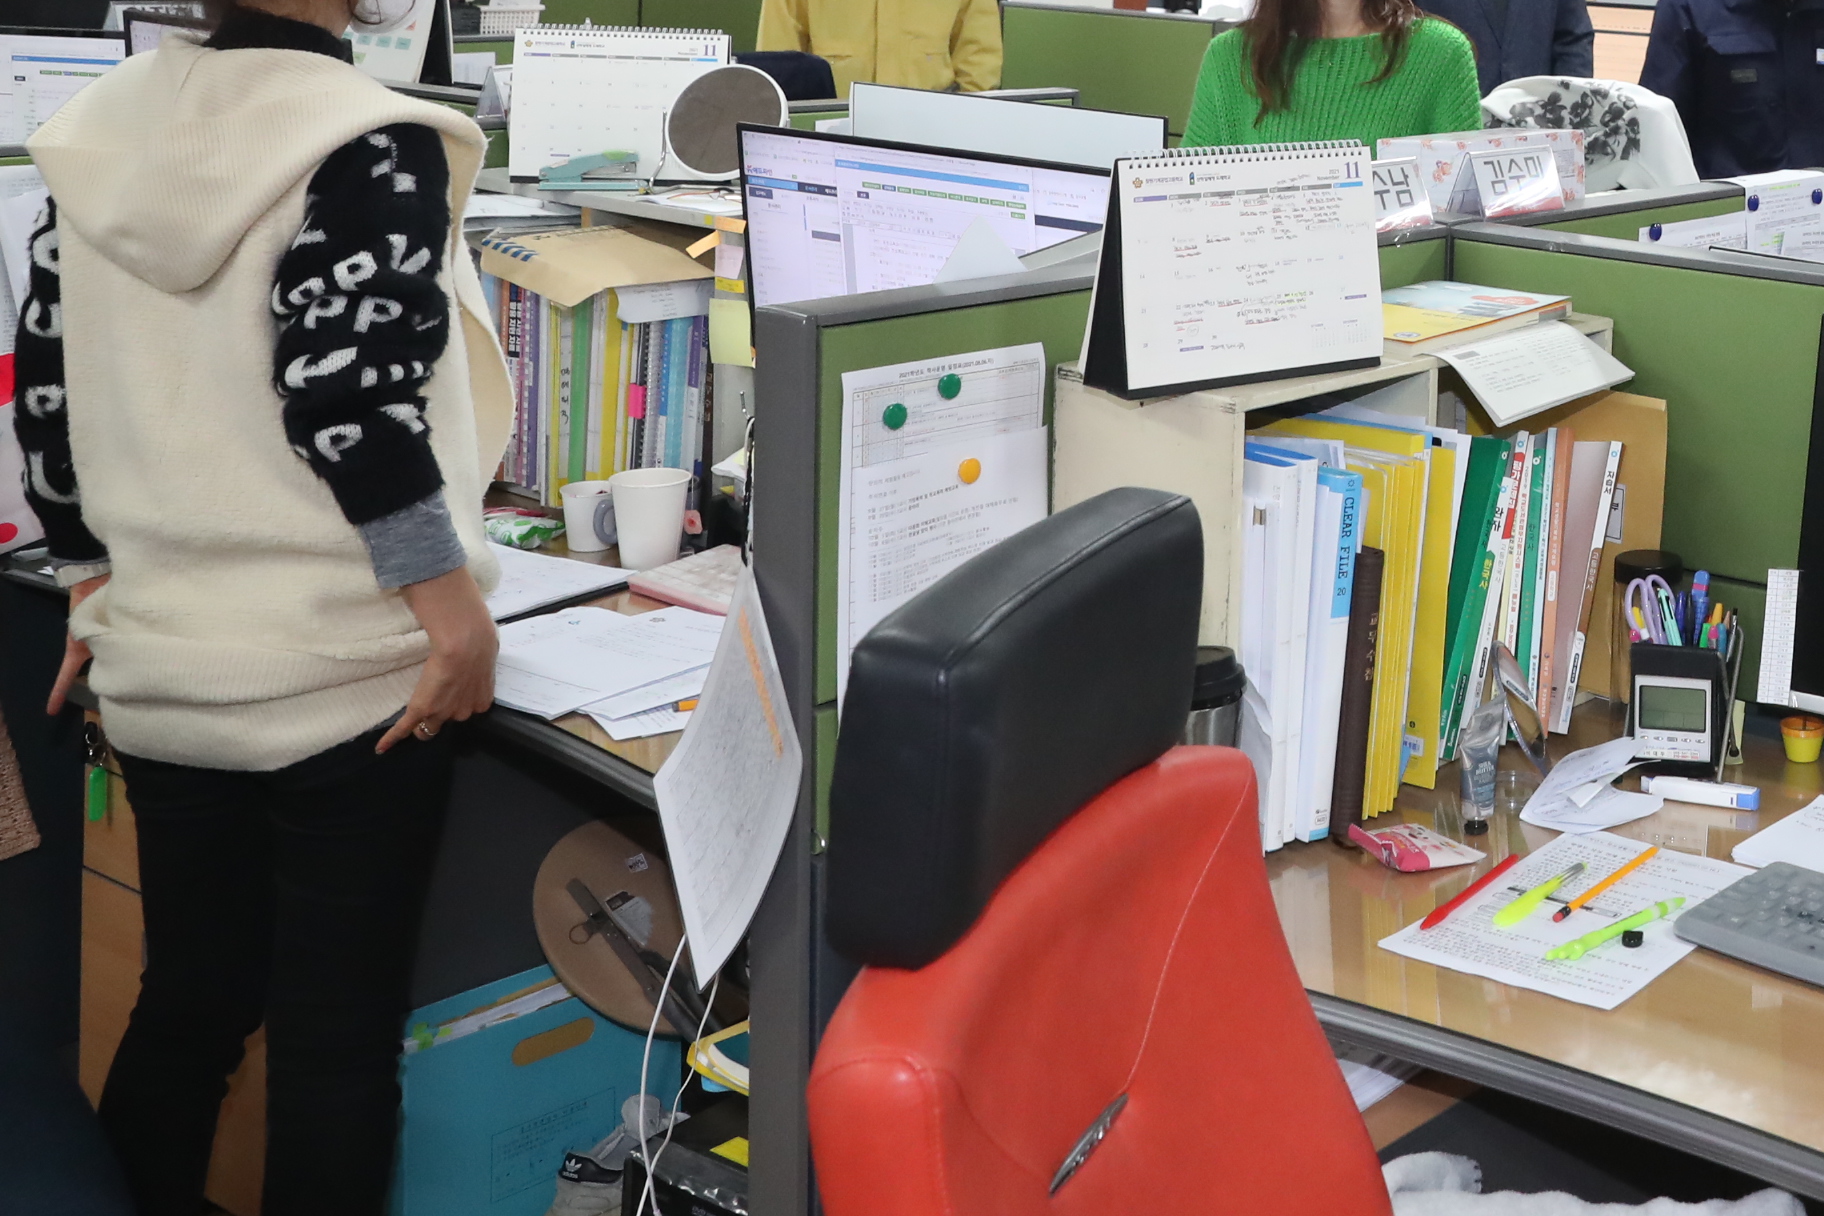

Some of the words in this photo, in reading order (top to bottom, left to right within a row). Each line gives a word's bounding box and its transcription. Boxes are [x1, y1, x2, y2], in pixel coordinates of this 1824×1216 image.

[704, 44, 717, 57] 11
[1344, 161, 1362, 179] 11
[1484, 155, 1545, 196] 김수미
[1603, 471, 1615, 495] 자습서
[1341, 496, 1355, 539] CLEAR
[1492, 507, 1504, 532] 완자
[1337, 546, 1350, 580] FILE
[1479, 559, 1493, 590] 한국사
[1586, 551, 1600, 592] 고등한국사
[1337, 587, 1347, 597] 20
[1364, 612, 1379, 681] 교무수첩
